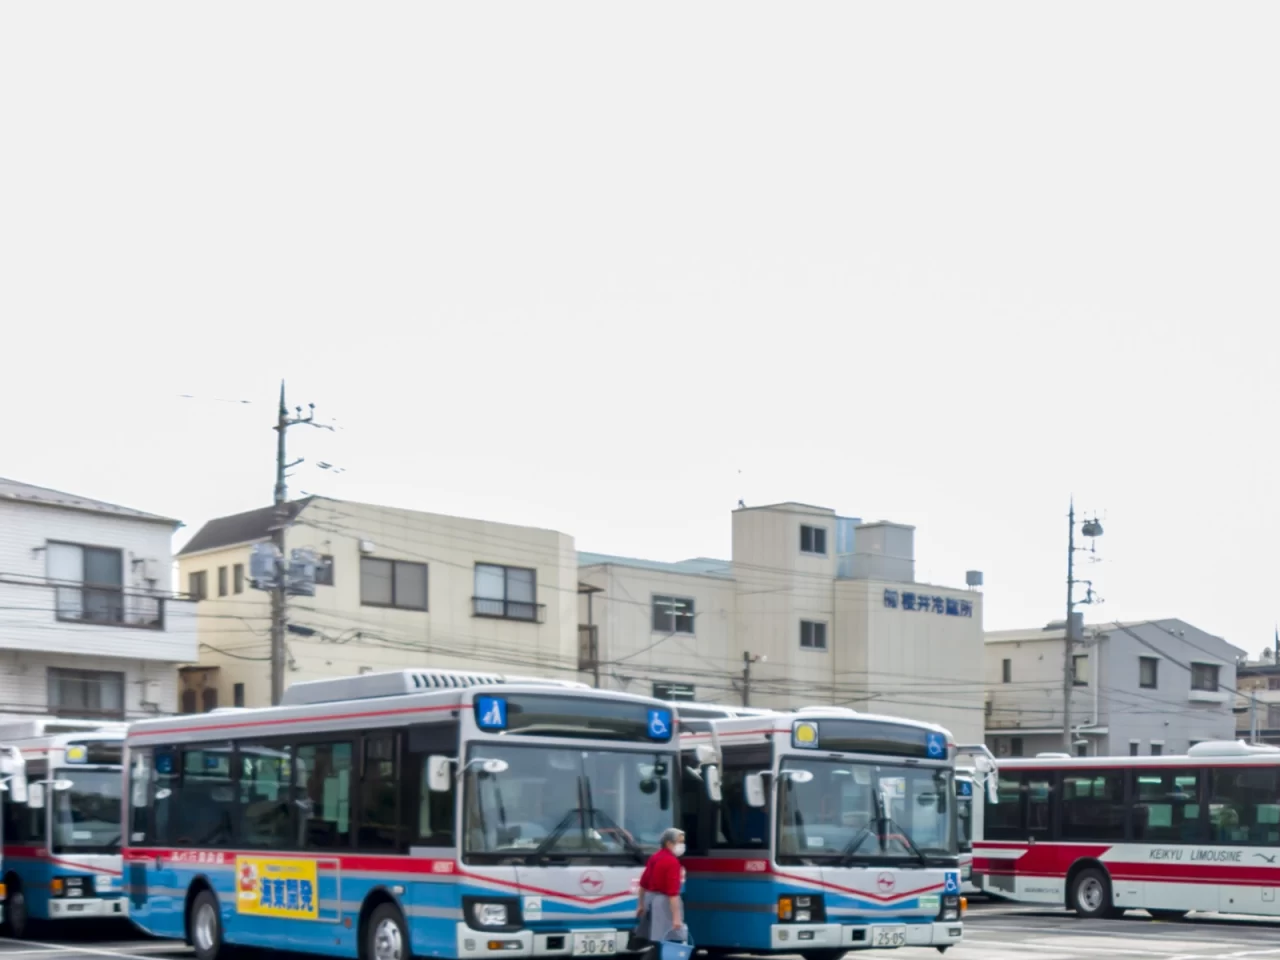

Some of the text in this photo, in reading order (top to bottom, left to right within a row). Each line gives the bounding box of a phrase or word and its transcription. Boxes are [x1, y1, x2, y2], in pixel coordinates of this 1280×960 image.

[1149, 848, 1243, 862] KEIKYU LIMOUSINE
[878, 931, 905, 945] 25-05
[581, 939, 614, 954] 30-28
